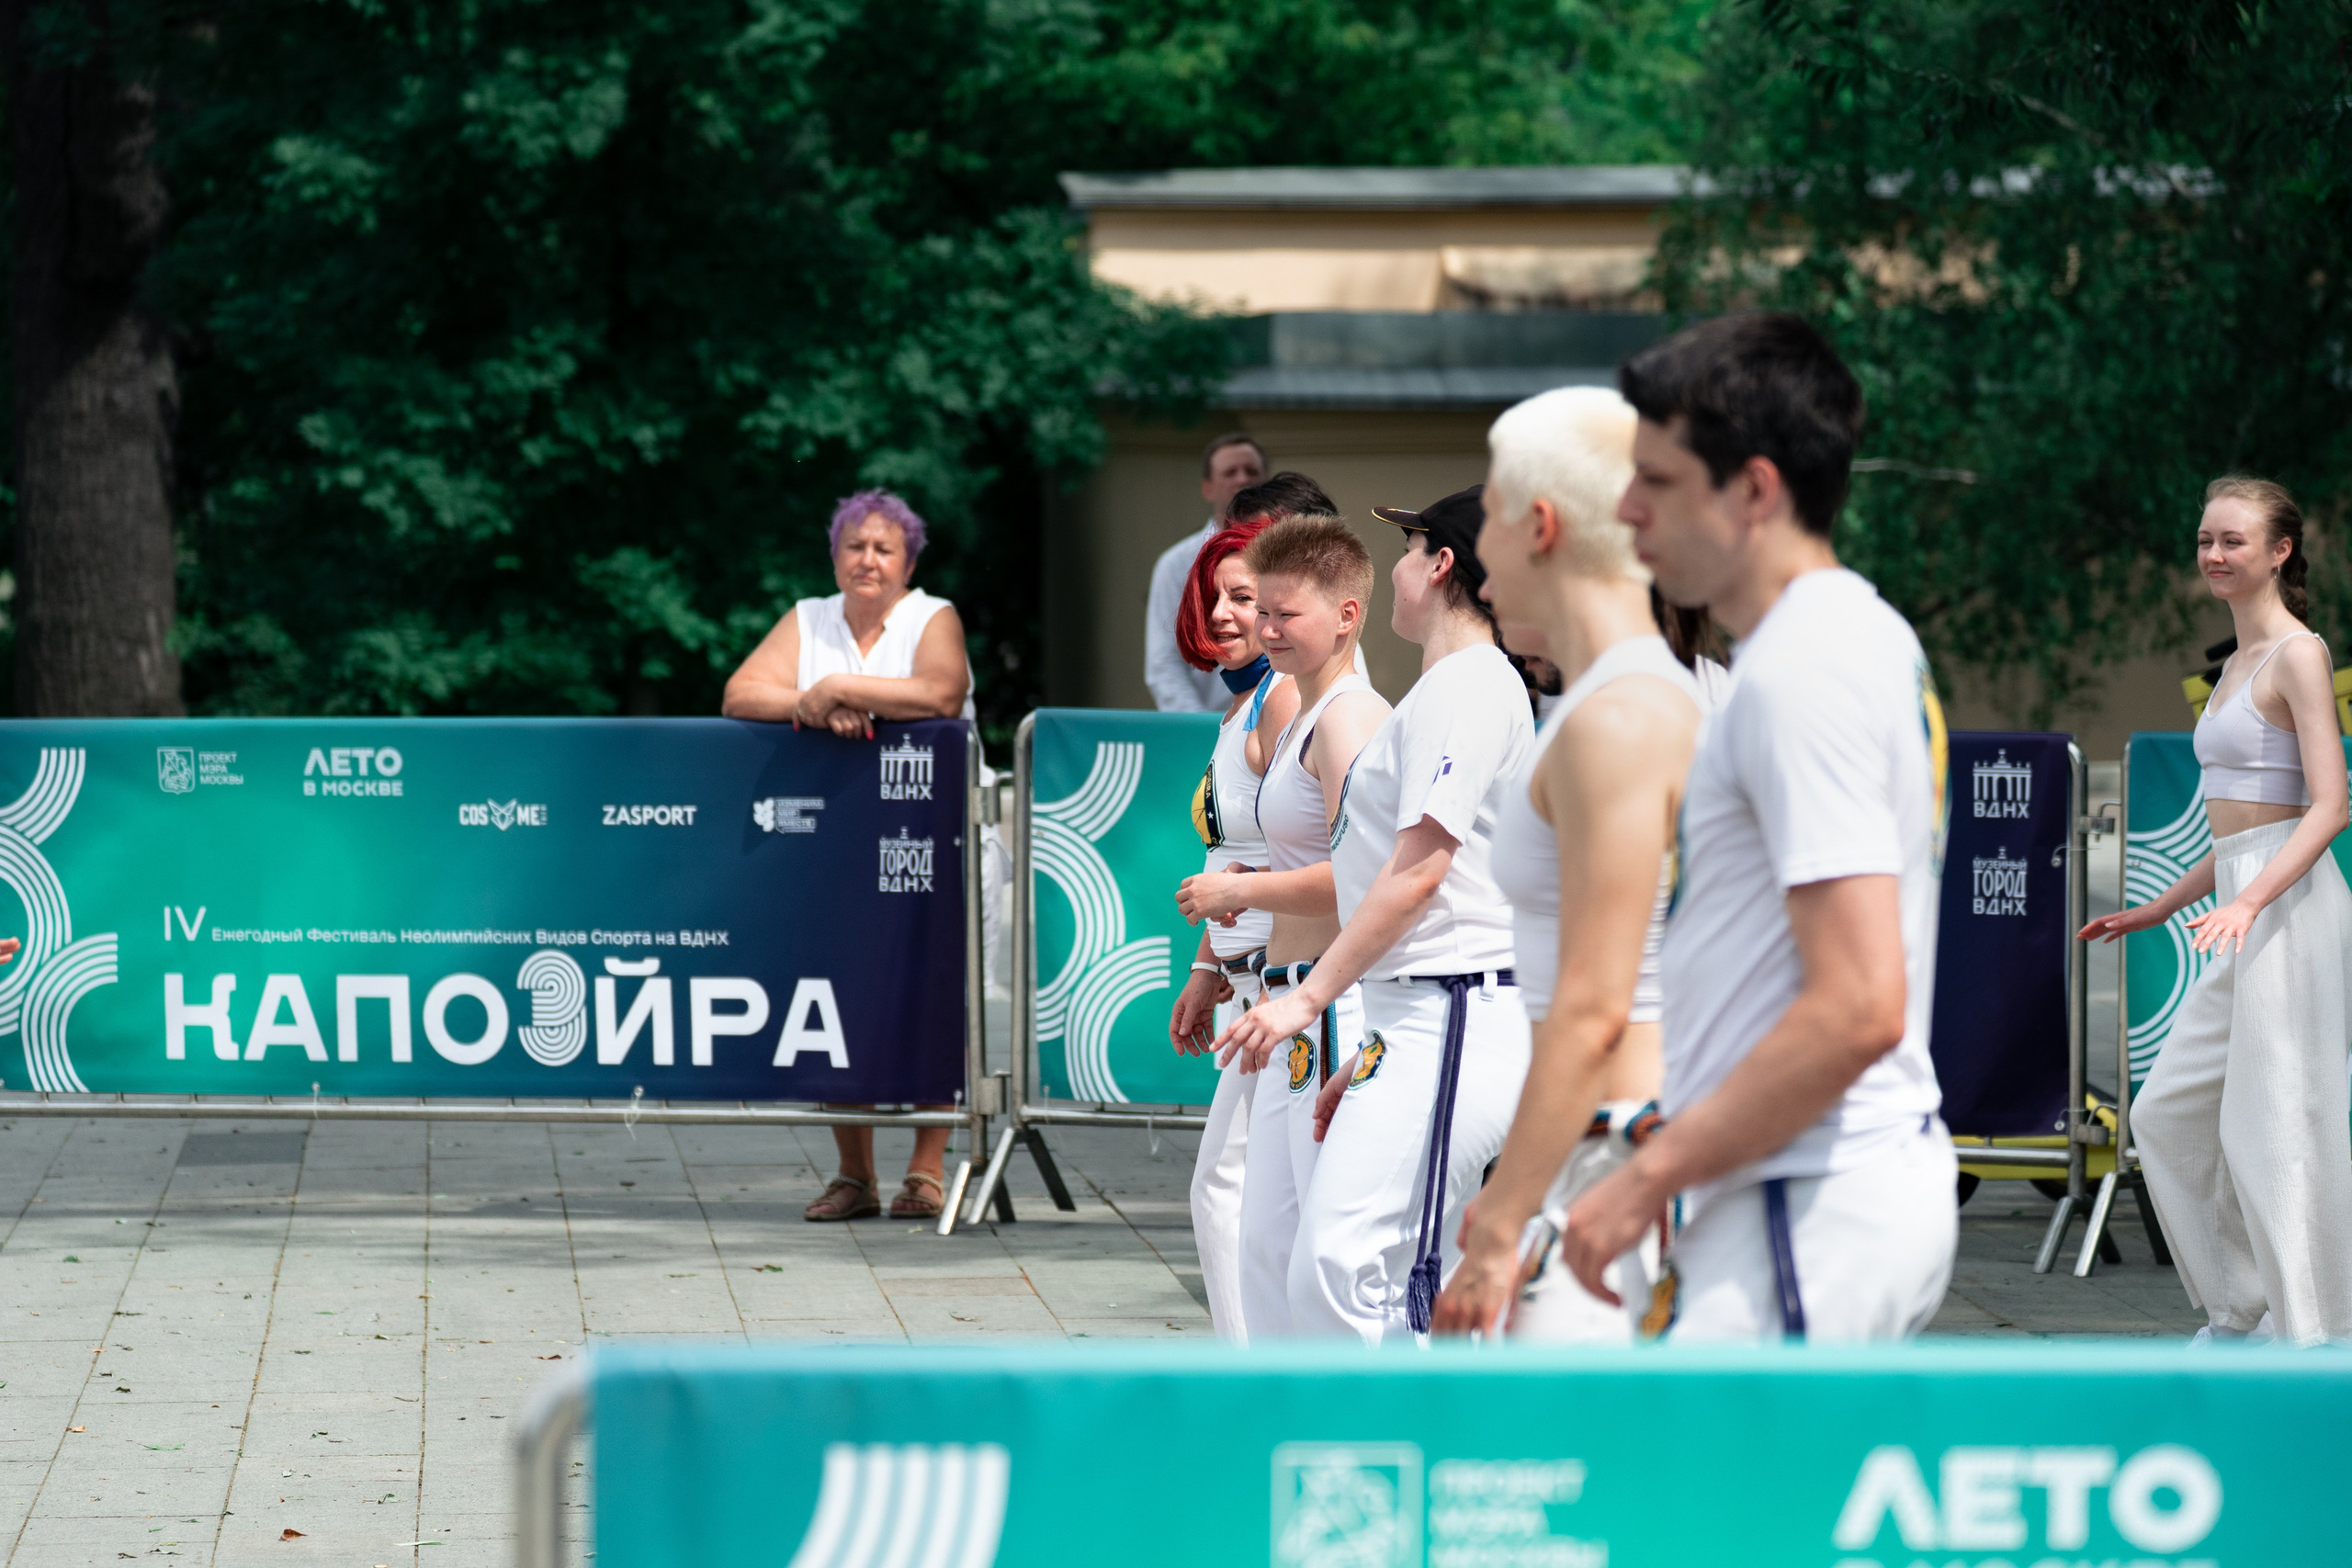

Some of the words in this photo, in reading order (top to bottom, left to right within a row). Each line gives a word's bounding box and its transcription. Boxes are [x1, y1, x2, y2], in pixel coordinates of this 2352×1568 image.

[198, 751, 237, 763] ПРОЕКТ
[303, 746, 403, 778] ЛЕТО
[199, 764, 228, 774] МЭРА
[199, 773, 244, 785] МОСКВЫ
[303, 780, 316, 796] В
[322, 780, 404, 797] МОСКВЕ
[880, 783, 933, 800] ВДНХ
[602, 805, 698, 826] ZASPORT
[1973, 800, 2030, 818] ВДНХ
[879, 849, 934, 875] ГОРОД
[878, 875, 934, 893] ВДНХ
[1973, 870, 2028, 897] ГОРОД
[1973, 898, 2028, 916] ВДНХ
[164, 906, 207, 941] IV
[211, 927, 303, 943] Ежегодный
[306, 928, 397, 943] Фестиваль
[401, 928, 532, 945] Неолимпийских
[536, 930, 588, 947] Видов
[591, 930, 651, 947] Спорта
[655, 932, 675, 945] на
[680, 931, 729, 947] ВДНХ
[1831, 1443, 2223, 1554] ЛЕТО
